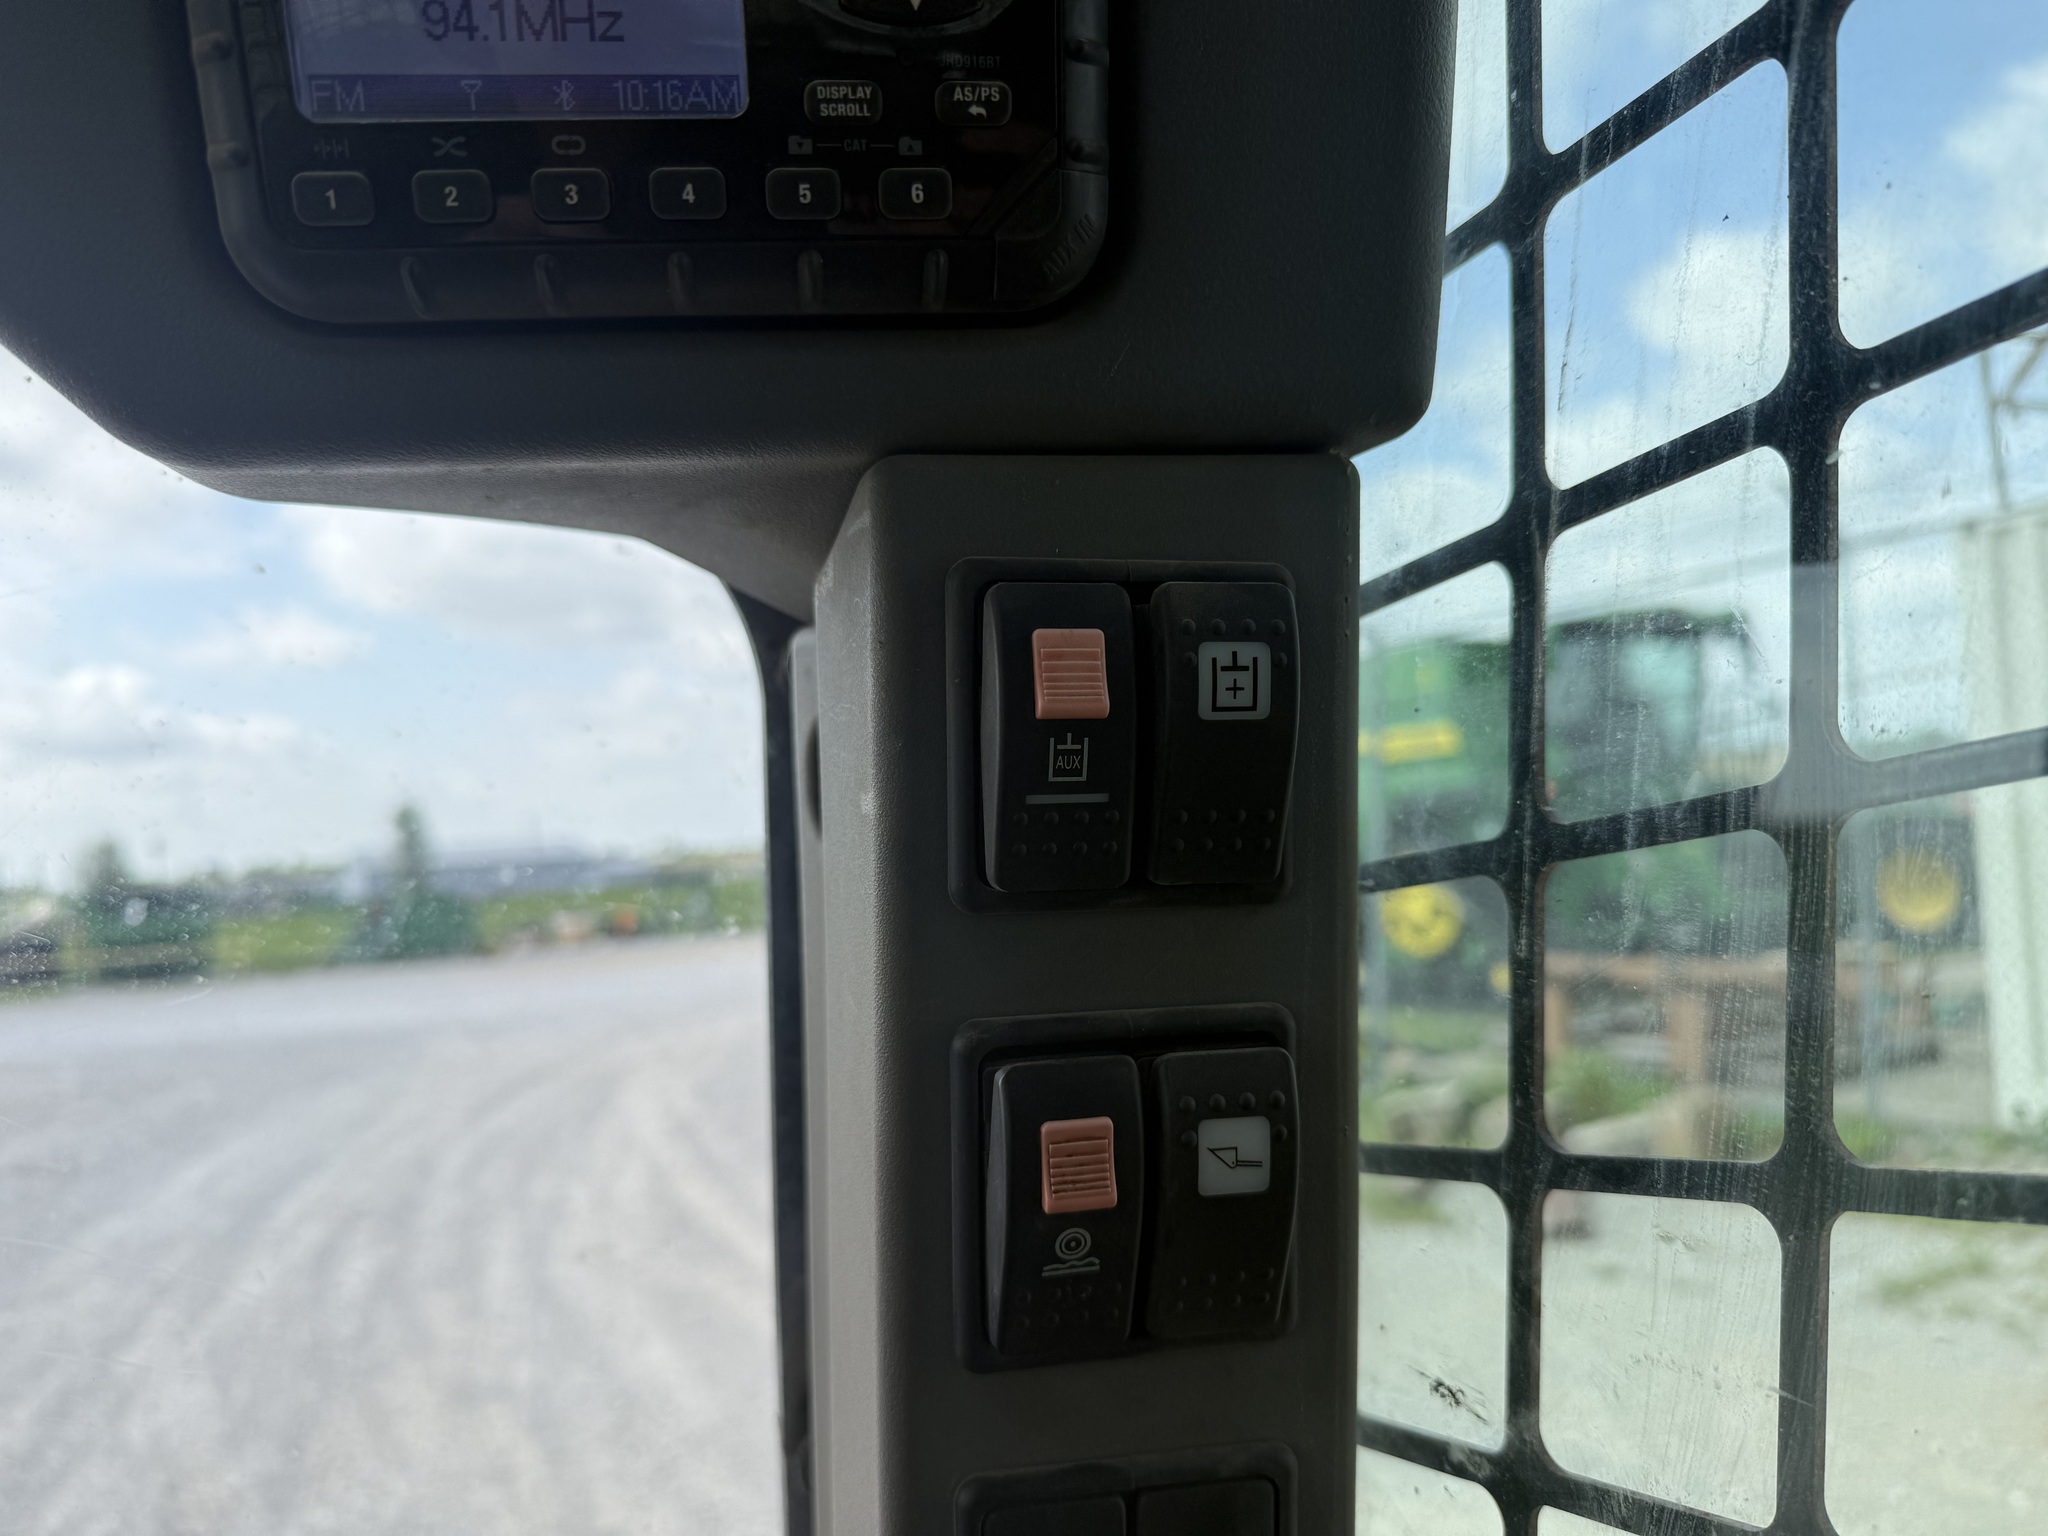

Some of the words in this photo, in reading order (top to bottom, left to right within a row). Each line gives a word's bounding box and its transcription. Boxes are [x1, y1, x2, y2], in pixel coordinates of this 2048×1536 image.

[421, 0, 625, 42] 94.1MHz
[311, 79, 366, 112] FM
[612, 79, 741, 112] 10:16AM
[816, 85, 873, 100] DISPLAY
[953, 86, 1001, 102] AS/PS
[819, 103, 871, 117] SCROLL
[843, 138, 869, 152] CAT
[324, 189, 338, 210] 1
[443, 186, 460, 208] 2
[564, 183, 580, 205] 3
[681, 182, 696, 204] 4
[798, 184, 812, 204] 5
[911, 183, 925, 204] 6
[1055, 754, 1082, 770] AUX
